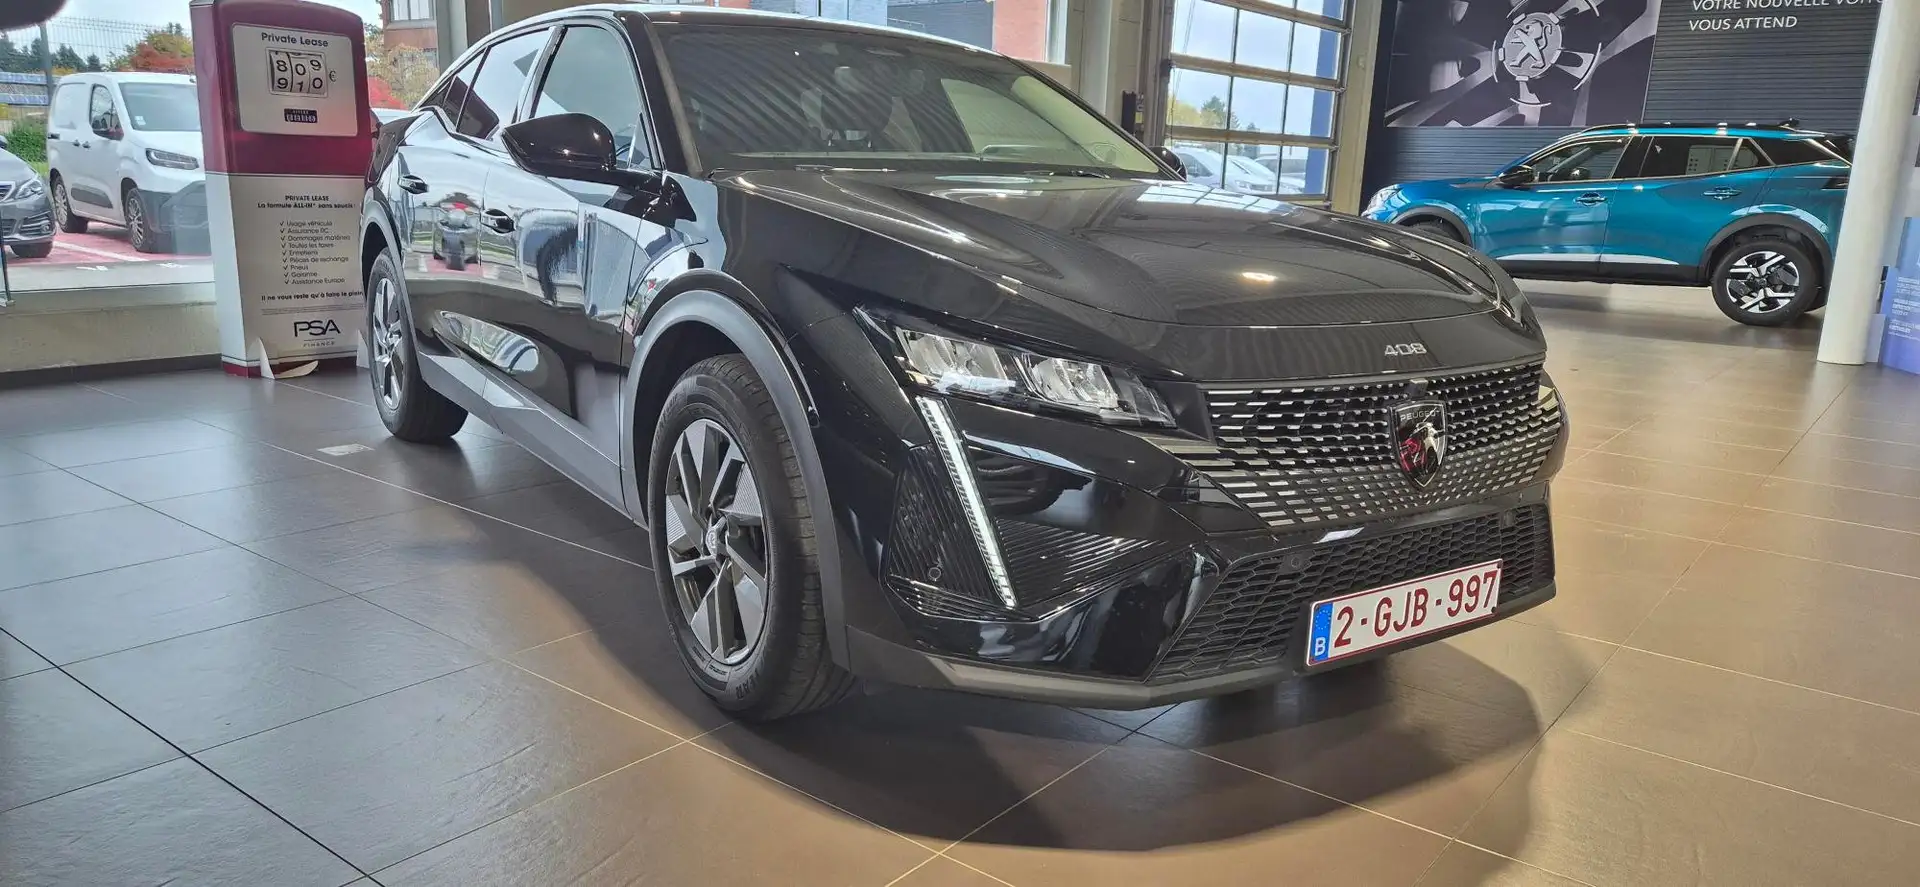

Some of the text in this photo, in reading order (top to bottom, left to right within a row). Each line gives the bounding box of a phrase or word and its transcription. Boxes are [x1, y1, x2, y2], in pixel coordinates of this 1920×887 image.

[1692, 0, 1741, 11] VOTRE
[1689, 16, 1798, 31] VOUS ATTEND
[261, 32, 329, 47] Private Lease
[329, 70, 337, 82] €
[293, 319, 341, 338] PSA
[1384, 342, 1427, 356] 408
[1334, 570, 1498, 648] 2-GJB-997
[1314, 637, 1326, 656] B
